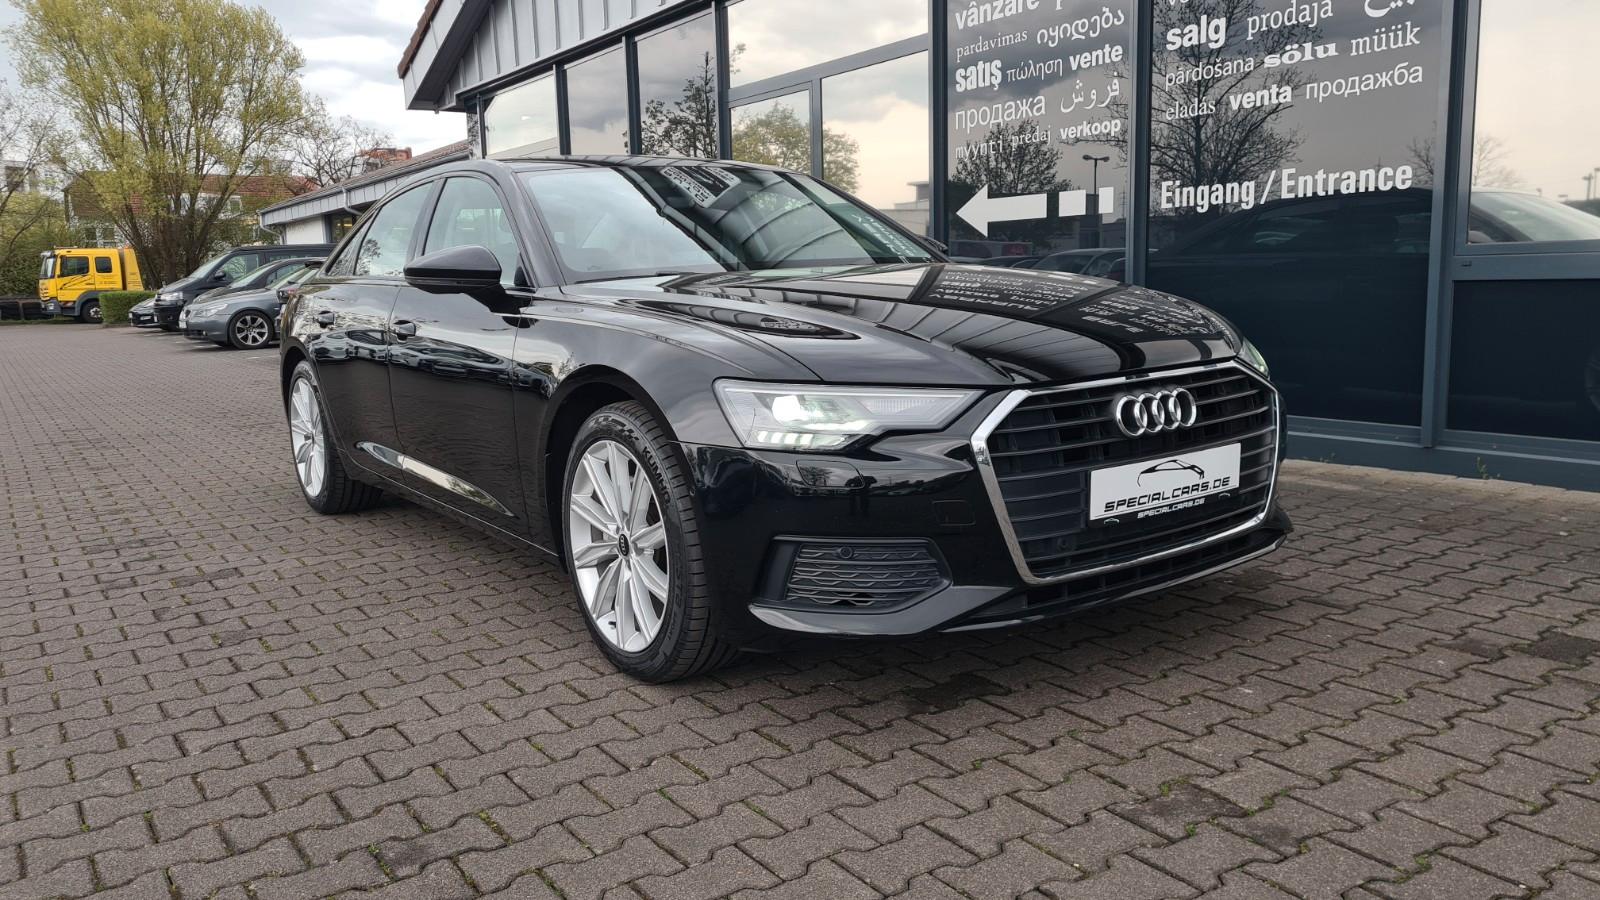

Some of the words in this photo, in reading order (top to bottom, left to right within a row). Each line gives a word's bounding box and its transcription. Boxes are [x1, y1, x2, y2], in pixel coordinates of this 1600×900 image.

[956, 30, 1028, 63] pardavimas
[1166, 14, 1227, 51] salg
[1247, 0, 1333, 40] prodaja
[955, 59, 1002, 93] satış
[1006, 57, 1063, 83] πώληση
[1069, 43, 1123, 71] vente
[1165, 57, 1254, 91] pārdošana
[1263, 41, 1339, 69] sölu
[1350, 20, 1421, 56] müük
[955, 95, 1046, 134] продажа
[1060, 72, 1120, 114] فروش
[1165, 96, 1216, 120] eladás
[1228, 83, 1292, 111] venta
[1306, 61, 1424, 102] продажба
[955, 134, 1003, 162] myynti
[1012, 124, 1051, 151] predaj
[1060, 119, 1121, 140] verkoop
[1160, 180, 1255, 214] Eingang
[1281, 165, 1413, 200] Entrance
[642, 446, 671, 504] KUMHO
[1103, 476, 1231, 513] SPECIALCARS.DE
[1137, 498, 1206, 519] SPECIALCARS.DE
